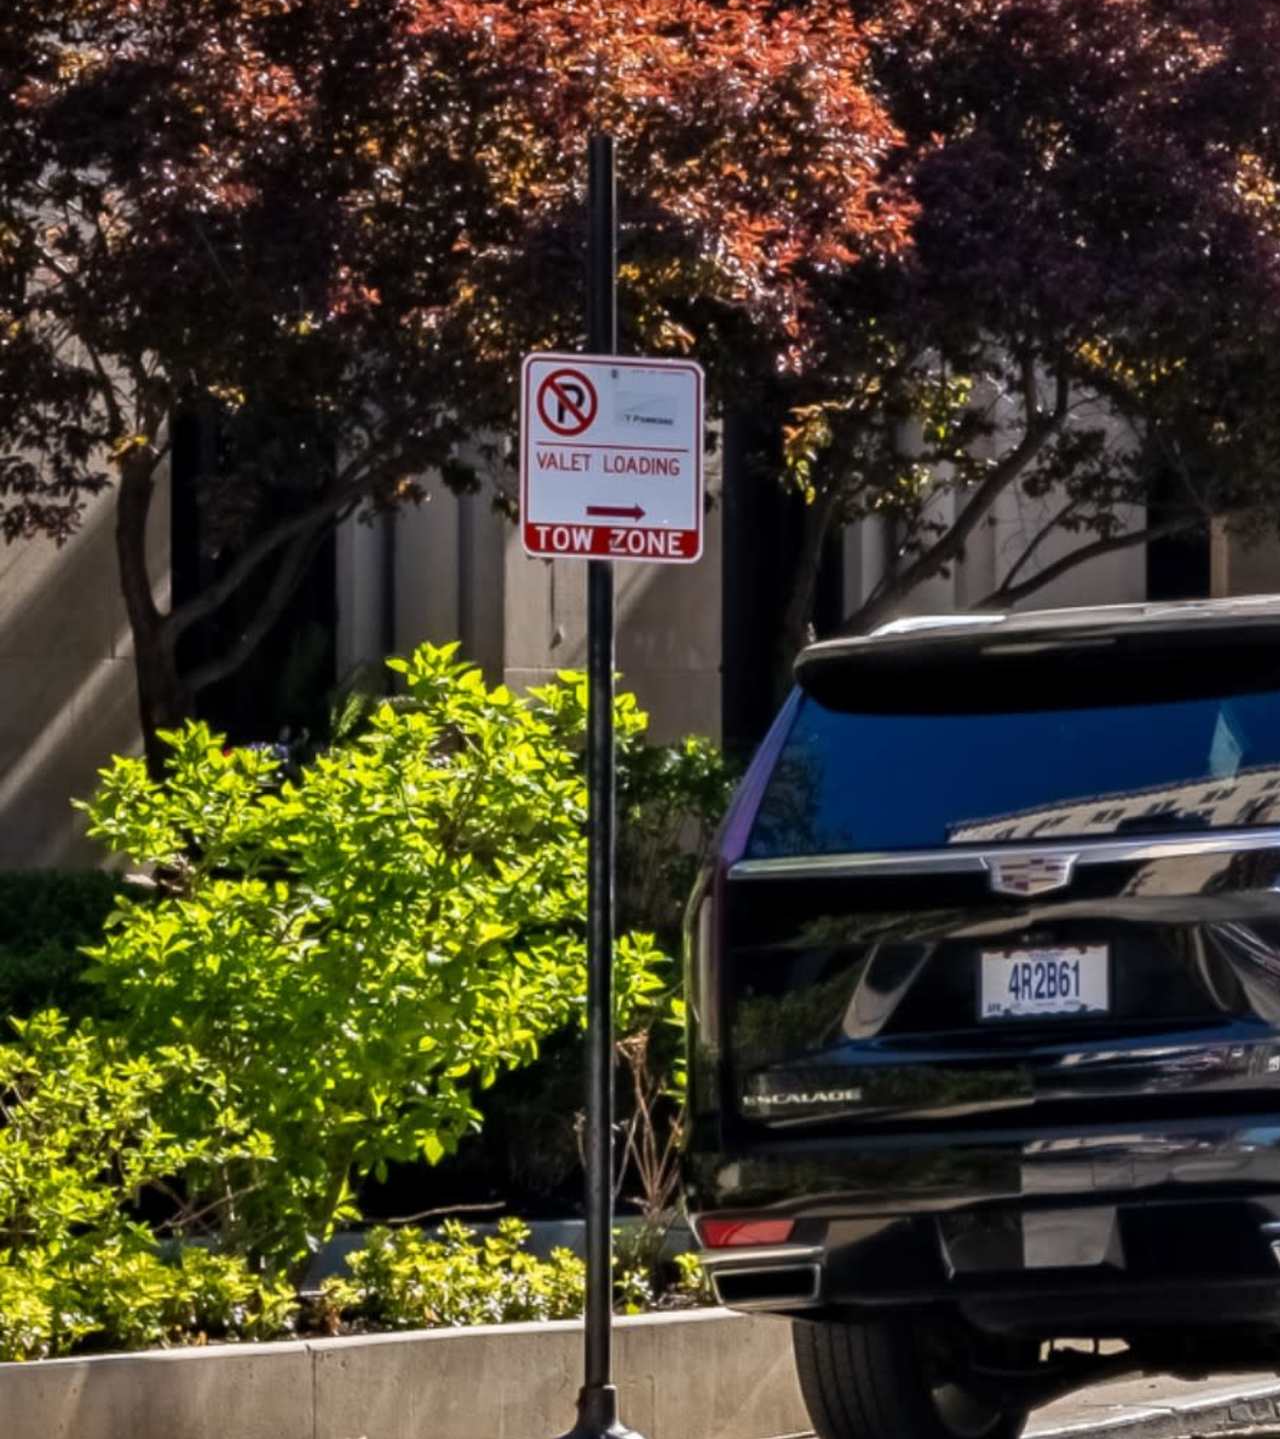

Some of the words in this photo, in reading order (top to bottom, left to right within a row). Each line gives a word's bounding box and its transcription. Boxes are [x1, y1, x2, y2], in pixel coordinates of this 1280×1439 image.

[537, 452, 591, 471] VALET
[603, 455, 680, 476] LOADING
[535, 526, 593, 551] TOW
[609, 529, 684, 556] ZONE
[1008, 961, 1080, 1001] 4R2B61
[742, 1088, 862, 1105] ESCALADE
